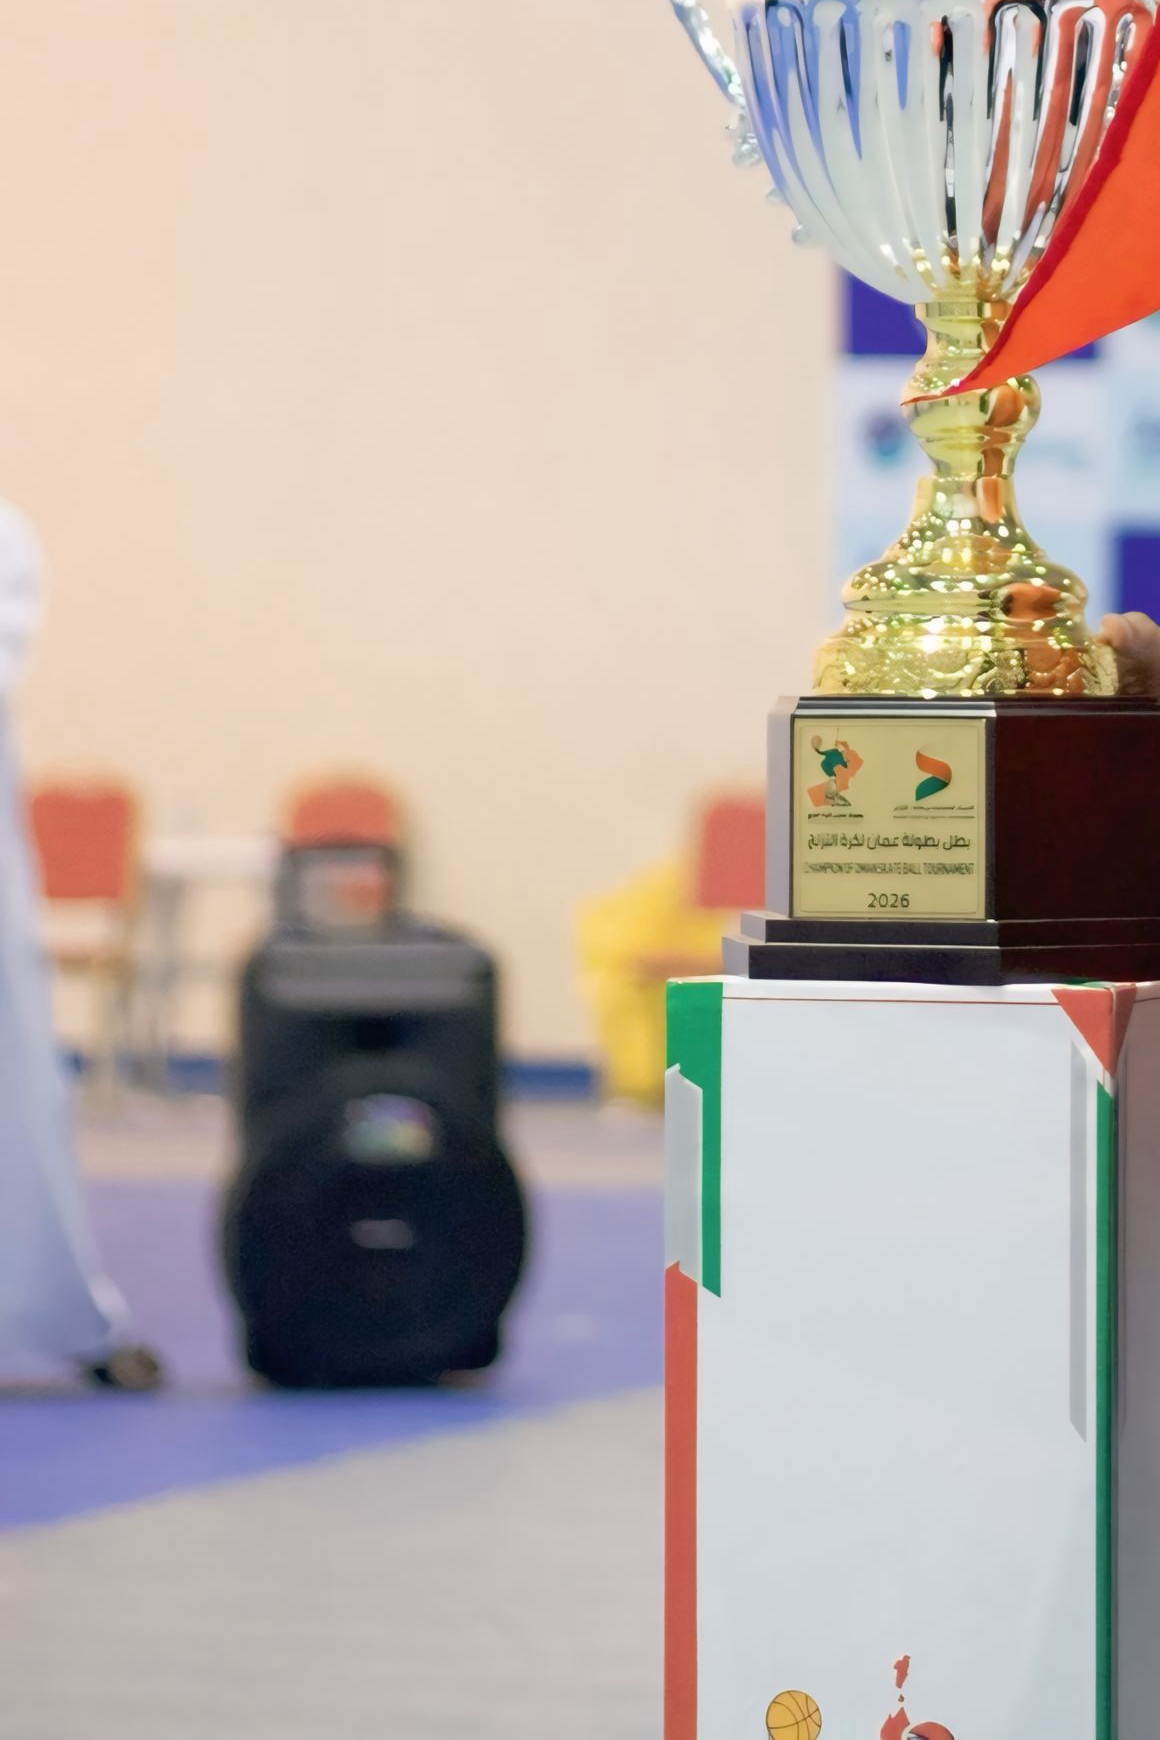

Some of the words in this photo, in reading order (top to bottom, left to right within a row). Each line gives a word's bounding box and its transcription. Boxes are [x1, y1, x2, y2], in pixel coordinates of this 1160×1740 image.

[866, 833, 900, 851] عمان
[901, 832, 940, 851] بطولة
[942, 834, 971, 851] بطل
[867, 892, 911, 909] 2026
